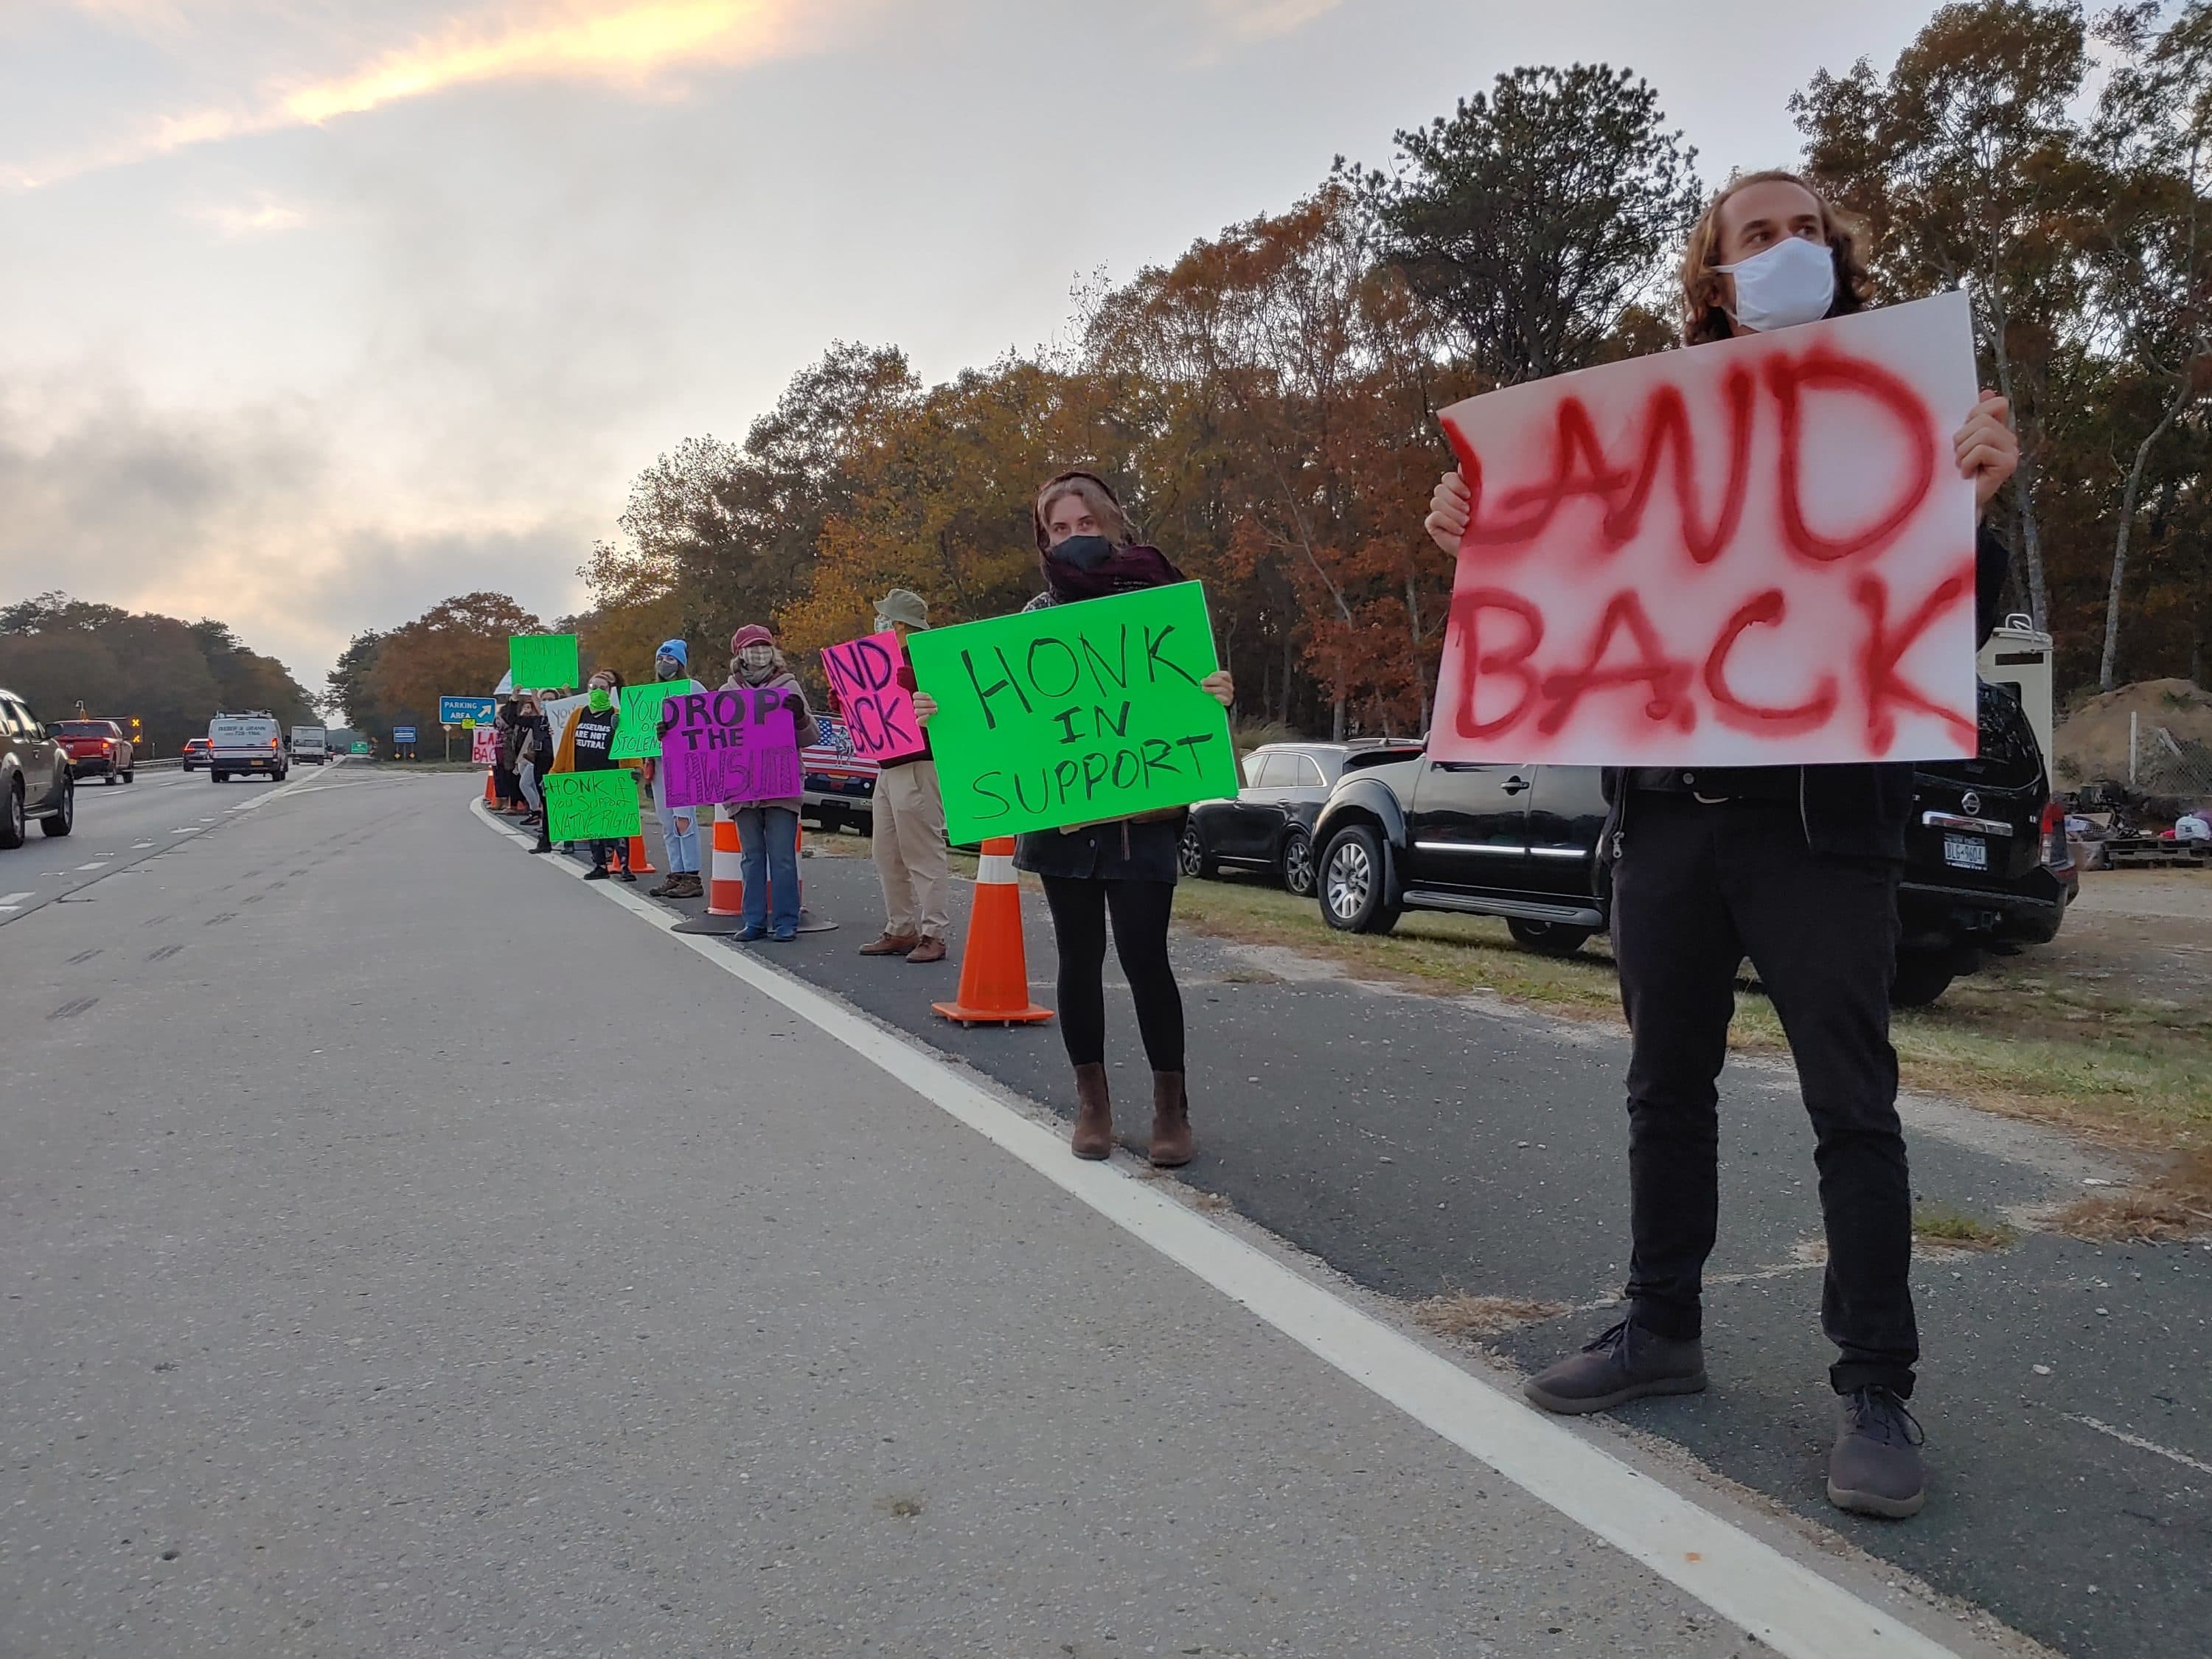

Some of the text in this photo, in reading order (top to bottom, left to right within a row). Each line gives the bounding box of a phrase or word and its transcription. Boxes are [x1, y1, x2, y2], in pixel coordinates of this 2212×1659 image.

[1439, 347, 1936, 563] LAND
[1448, 555, 1978, 755] BACK
[961, 623, 1199, 730] HONK
[445, 701, 477, 709] PARKING
[627, 689, 659, 726] YOU
[662, 689, 780, 731] DROP
[839, 692, 913, 754] BACK
[1051, 701, 1130, 744] IN
[478, 731, 495, 745] LA
[575, 730, 607, 740] ARE NOT
[613, 730, 662, 754] STOLEN
[682, 728, 744, 751] THE
[474, 747, 496, 762] BAC
[549, 775, 611, 796] HONK
[664, 746, 795, 804] LAWSUIT
[973, 734, 1213, 819] SUPPORT
[554, 810, 639, 837] NATIVE RIGHTS
